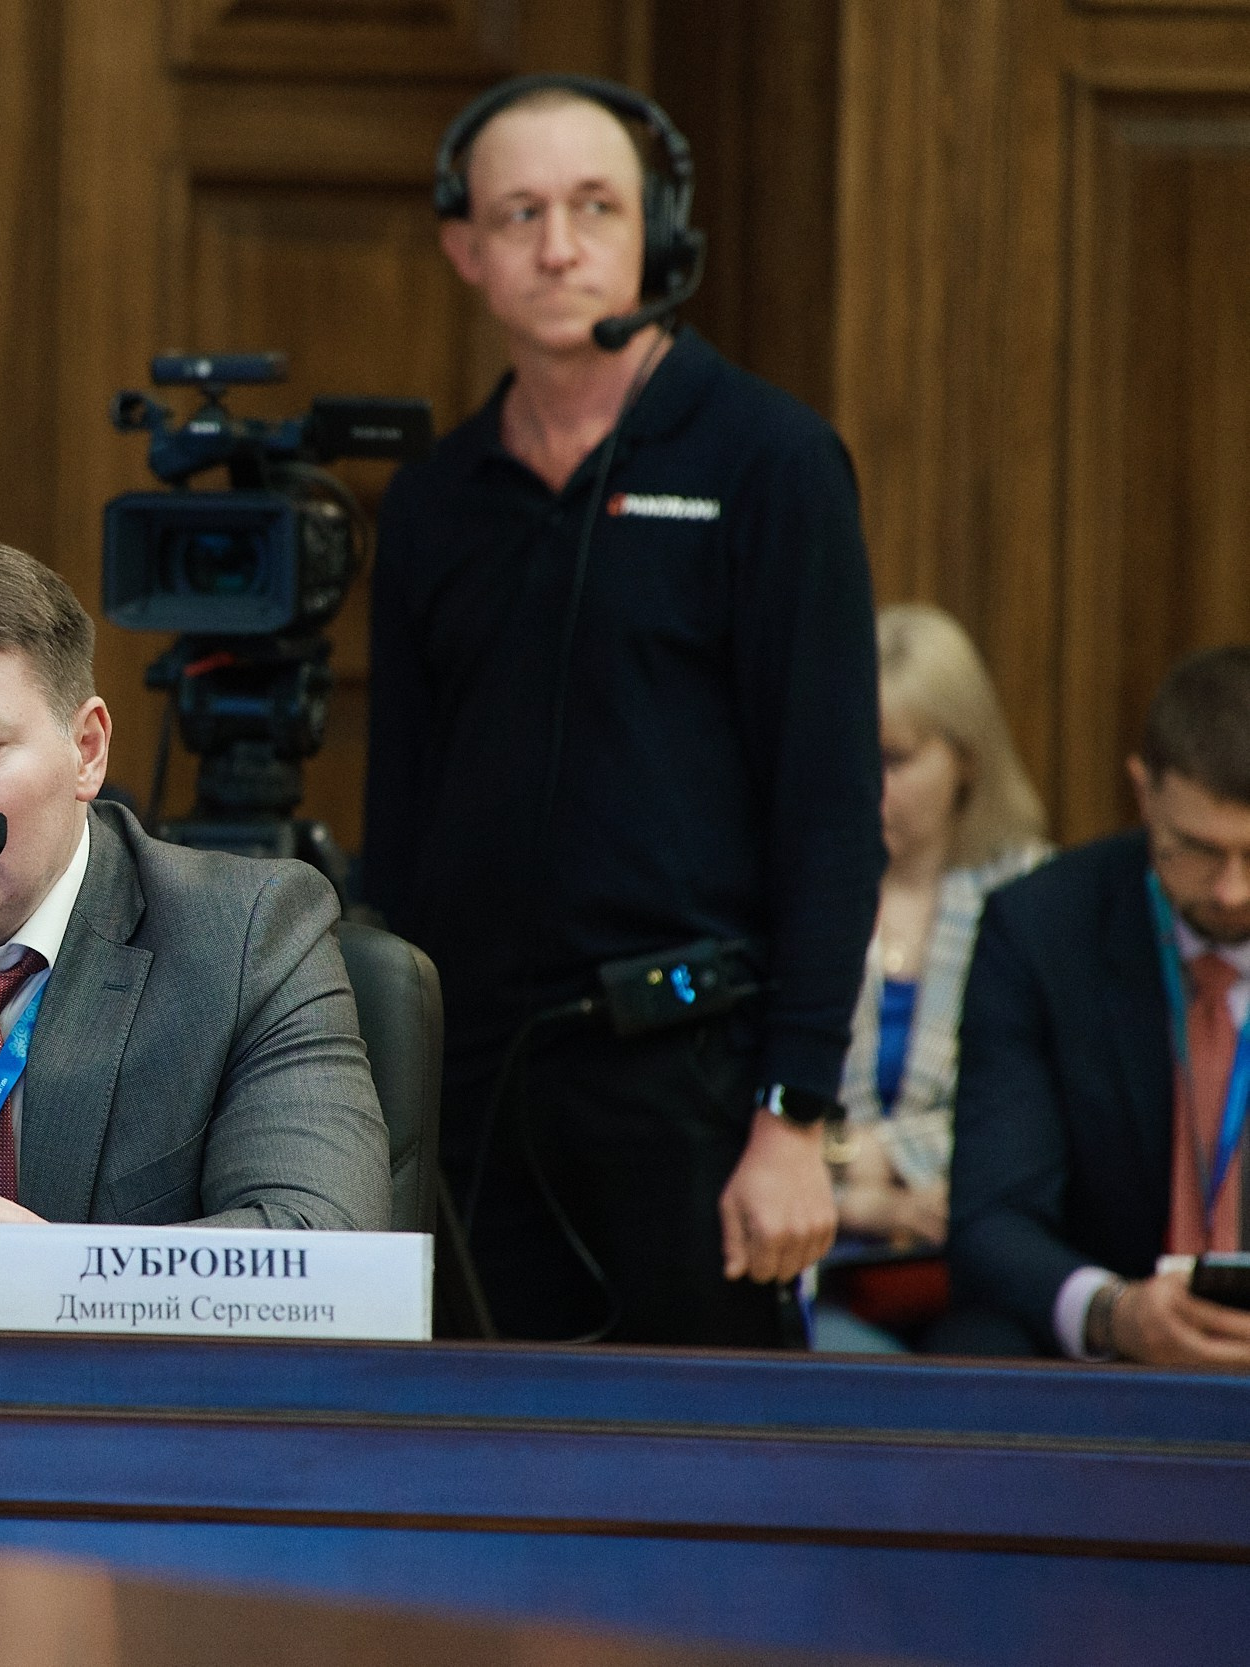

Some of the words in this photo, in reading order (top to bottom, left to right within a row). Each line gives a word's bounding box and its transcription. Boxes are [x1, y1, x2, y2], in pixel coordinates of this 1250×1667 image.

[79, 1246, 310, 1282] ДУБРОВИН
[56, 1293, 180, 1326] Дмитрий
[191, 1295, 336, 1328] Сергеевич
